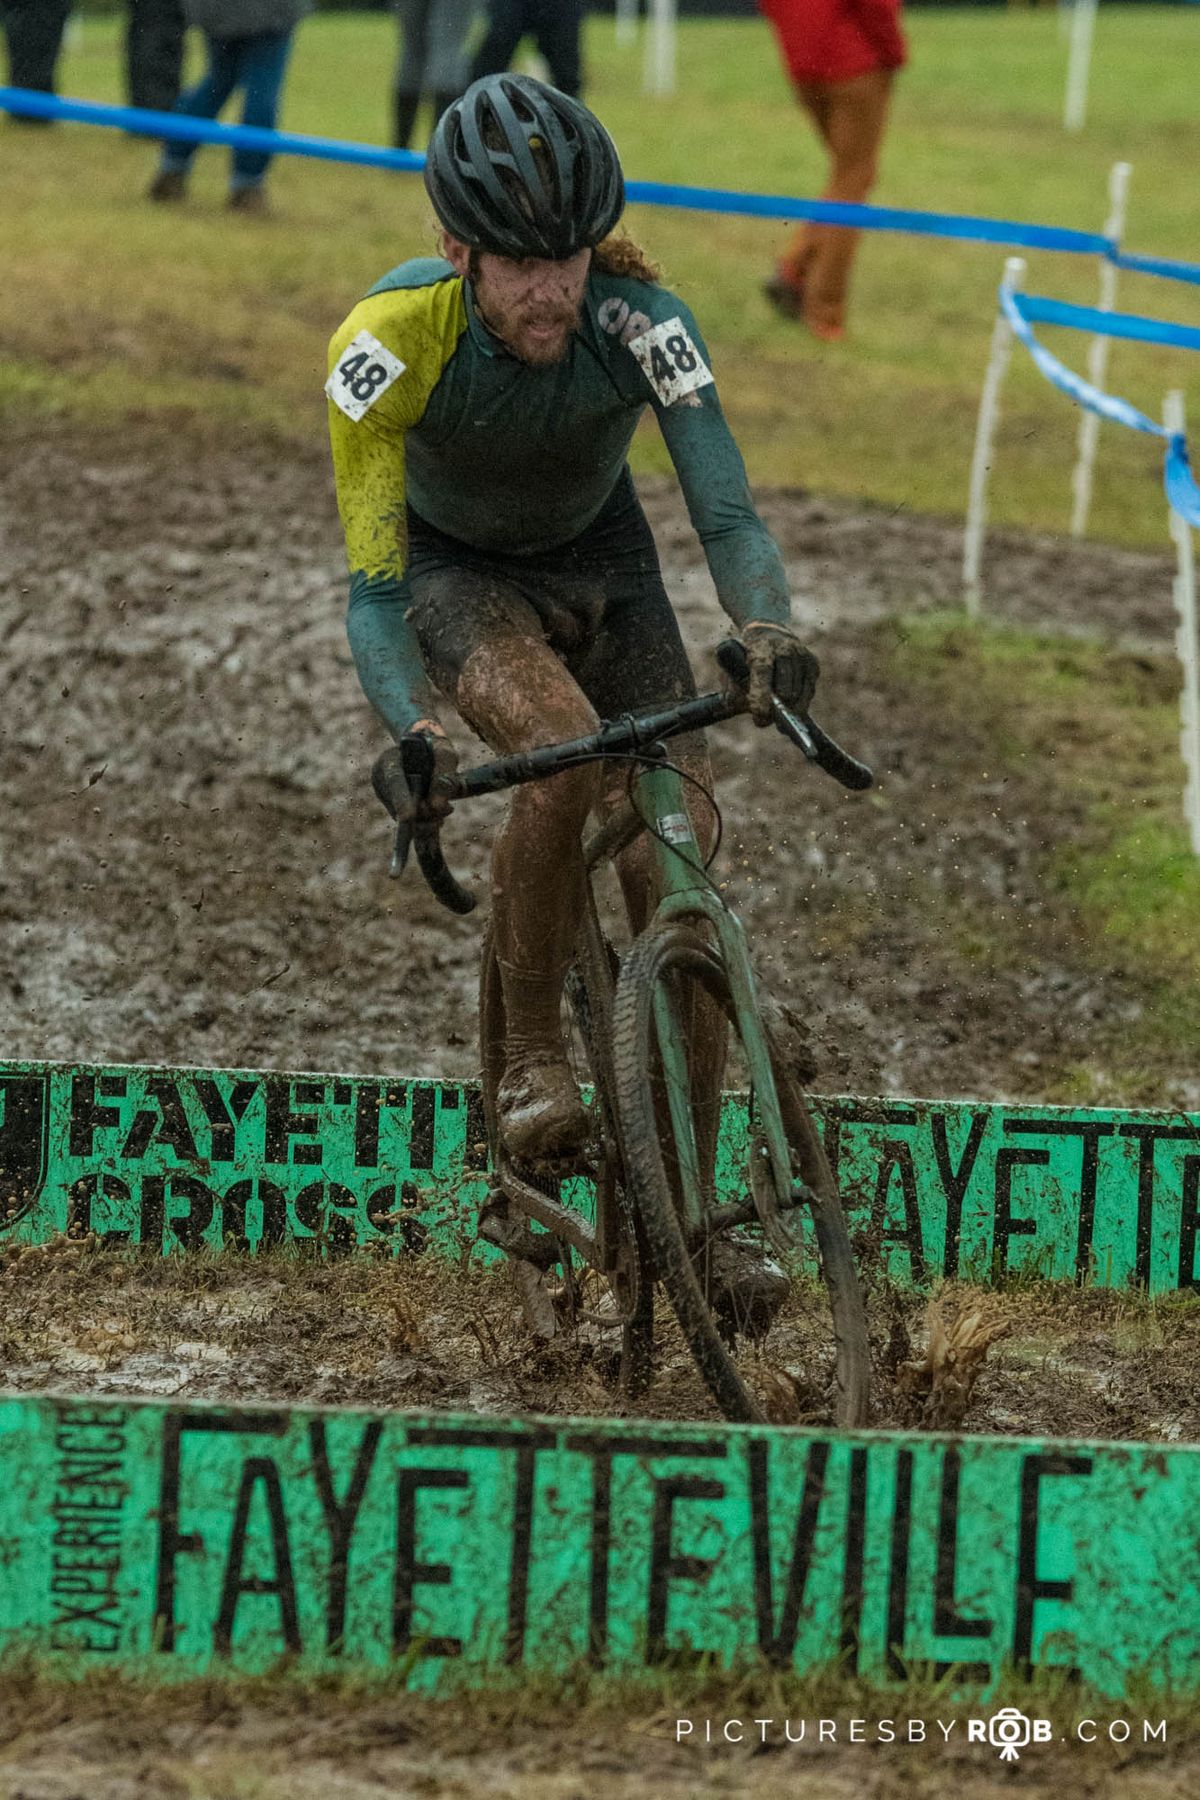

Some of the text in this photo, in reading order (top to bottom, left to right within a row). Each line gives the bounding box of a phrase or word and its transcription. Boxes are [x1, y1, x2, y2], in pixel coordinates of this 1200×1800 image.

[339, 351, 388, 401] 48
[650, 335, 698, 384] 48
[67, 1172, 428, 1255] CROSS
[50, 1404, 127, 1652] EXPERIENCE
[155, 1413, 1093, 1686] FAYETTEVILLE
